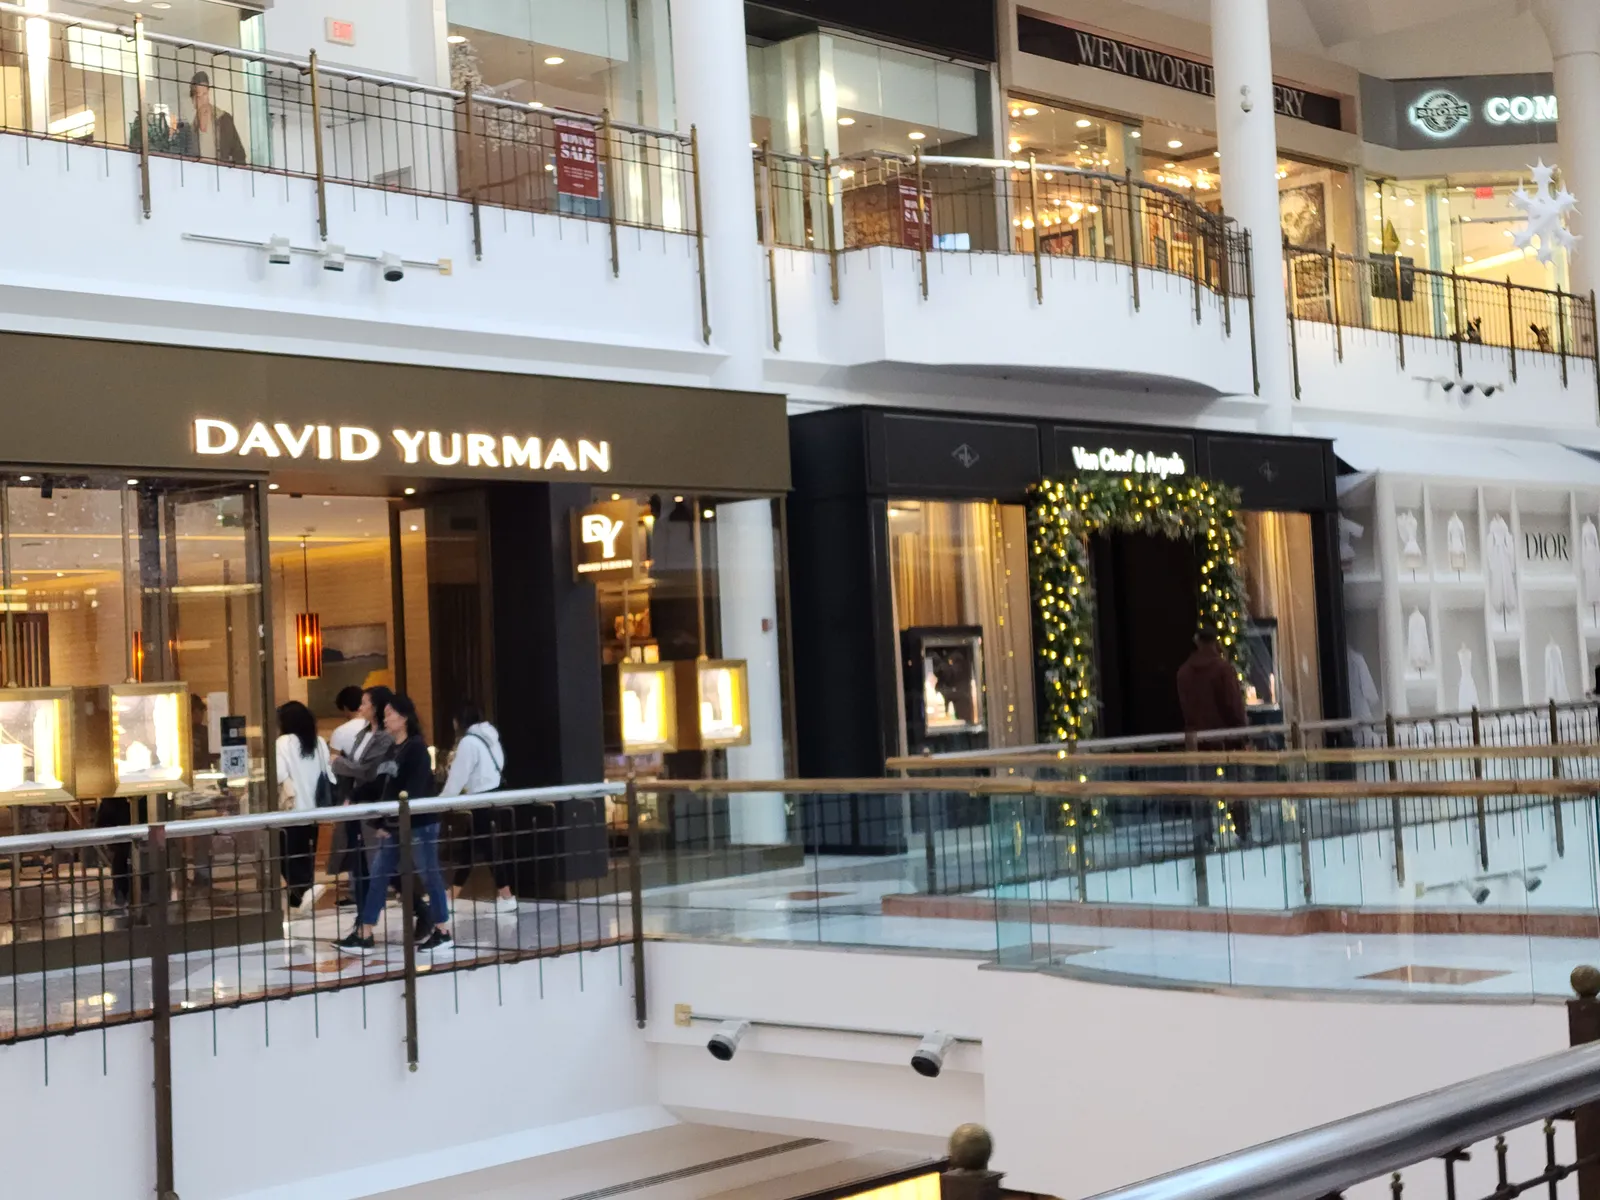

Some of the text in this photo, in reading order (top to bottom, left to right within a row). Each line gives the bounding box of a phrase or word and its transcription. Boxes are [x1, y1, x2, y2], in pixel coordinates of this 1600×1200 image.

[1075, 31, 1215, 97] WENTWORTH
[560, 143, 596, 163] SALE
[194, 418, 612, 473] DAVID YURMAN
[581, 513, 624, 559] DY
[1525, 531, 1569, 562] DIOR
